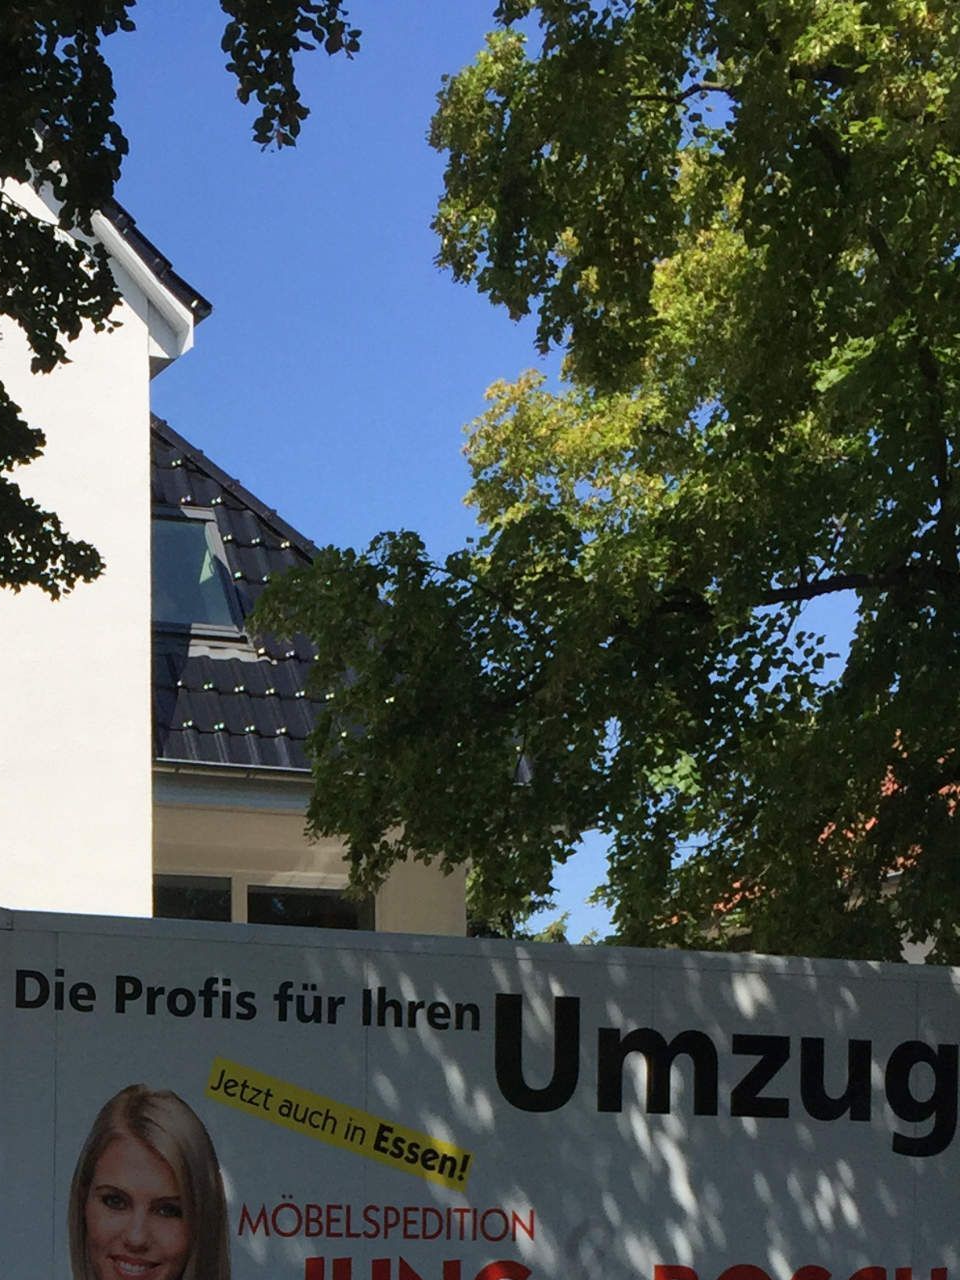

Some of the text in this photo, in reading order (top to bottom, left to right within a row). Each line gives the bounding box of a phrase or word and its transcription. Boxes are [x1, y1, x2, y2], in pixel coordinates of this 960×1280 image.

[15, 968, 960, 1157] Die Profis für Ihren Umzug
[210, 1069, 471, 1182] Jetzt auch in Essen!
[238, 1194, 535, 1242] MÖBELSPEDITION
